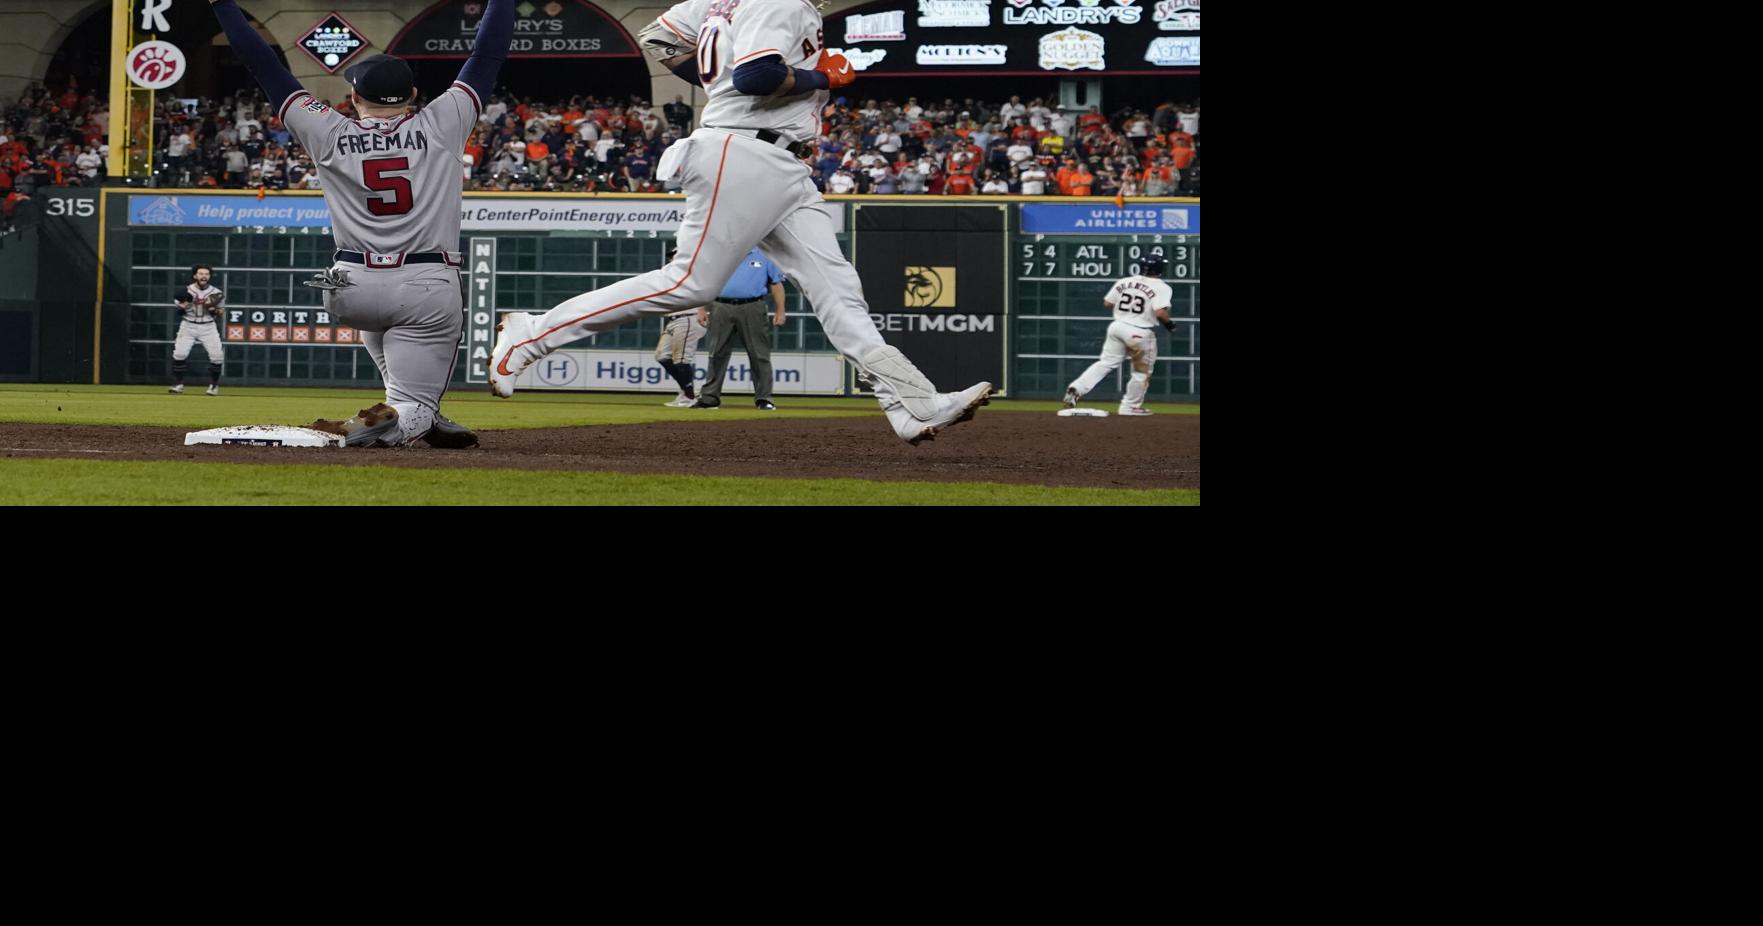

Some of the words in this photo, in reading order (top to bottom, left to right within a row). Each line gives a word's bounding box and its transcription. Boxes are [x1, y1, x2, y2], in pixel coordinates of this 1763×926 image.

[141, 0, 173, 32] R
[1004, 7, 1142, 24] LANDRY'S
[461, 19, 563, 32] LARY'S
[306, 39, 360, 48] CRAWFORD
[425, 39, 533, 51] CRAWRD
[542, 39, 601, 51] BOXES
[337, 130, 428, 155] FREEMAN
[362, 157, 413, 216] 5
[46, 198, 95, 216] 315
[198, 204, 234, 221] Help
[236, 206, 293, 222] protect
[1091, 210, 1157, 219] UNITED
[237, 226, 243, 234] 1
[255, 226, 264, 234] 2
[278, 226, 287, 234] 3
[321, 227, 330, 235] 5
[1075, 219, 1157, 228] AIRLINES
[607, 230, 613, 238] 1
[627, 230, 635, 238] 2
[649, 230, 658, 238] 3
[1132, 234, 1138, 242] 1
[1154, 234, 1163, 243] 2
[1023, 245, 1034, 258] 5
[1044, 245, 1056, 258] 4
[1076, 245, 1109, 259] ATL
[1129, 246, 1140, 259] 0
[1176, 246, 1187, 260] 3
[1023, 262, 1034, 276] 7
[1045, 262, 1056, 276] 7
[1071, 262, 1112, 276] HOU
[1129, 263, 1140, 276] 0
[1175, 264, 1187, 278] 0
[472, 244, 491, 376] NATIONAL
[1118, 293, 1145, 315] 23
[868, 313, 995, 332] BETMGM
[597, 361, 801, 385] Higgbthm
